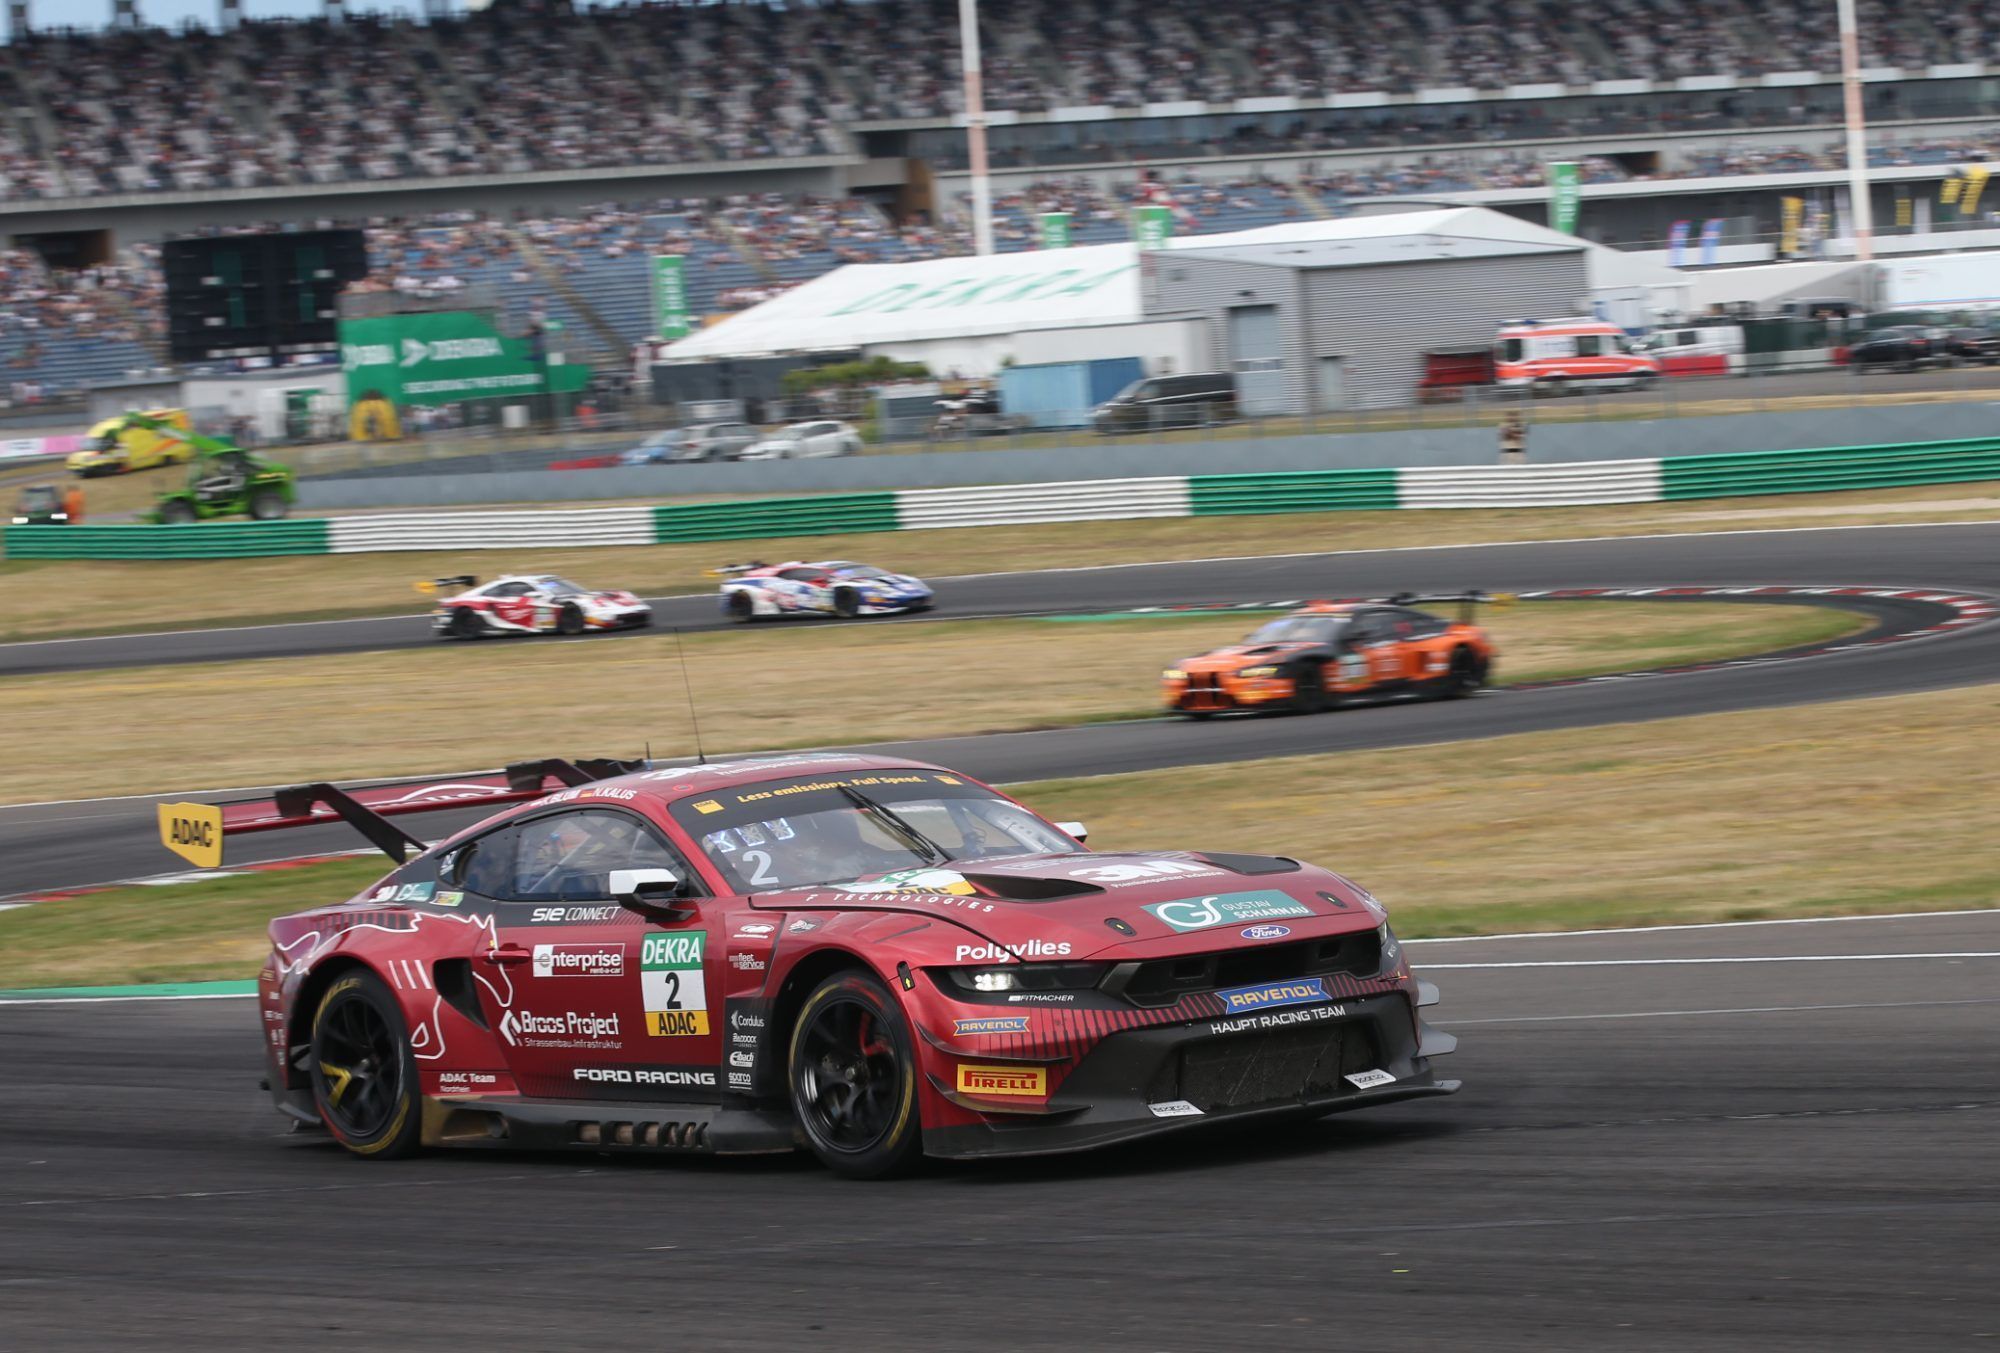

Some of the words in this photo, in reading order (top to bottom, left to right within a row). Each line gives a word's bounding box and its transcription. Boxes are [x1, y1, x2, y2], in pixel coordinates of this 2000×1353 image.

[820, 263, 1140, 318] DEKRA
[737, 792, 772, 803] Less
[773, 781, 851, 796] emissions.
[853, 777, 879, 787] Full
[881, 776, 927, 785] Speed.
[170, 817, 213, 848] ADAC
[743, 850, 780, 886] 2
[1068, 861, 1207, 881] 3M
[565, 906, 621, 921] CONNECT
[833, 893, 995, 914] TECHNOLOGIES
[1156, 897, 1219, 928] GS
[1222, 899, 1271, 911] GUSTAV
[1233, 906, 1310, 919] SCHARNAU
[1250, 926, 1283, 938] Ford
[539, 950, 621, 971] enterprise
[642, 937, 702, 965] DEKRA
[955, 939, 1072, 961] Polyvlies
[664, 972, 682, 1009] 2
[1230, 985, 1318, 1007] RAVENOL
[520, 1011, 566, 1034] Broos
[566, 1011, 619, 1038] Project
[658, 1012, 697, 1035] ADAC
[738, 1015, 765, 1027] Cordulus
[961, 1020, 1022, 1031] RAVENOL
[1211, 1018, 1257, 1035] HAUPT
[1261, 1011, 1311, 1027] RACING
[1311, 1005, 1346, 1020] TEAM
[440, 1073, 468, 1083] ADAC
[469, 1073, 496, 1083] Team
[573, 1068, 632, 1083] FORD
[635, 1070, 717, 1086] RACING
[964, 1070, 1038, 1090] PIRELLI
